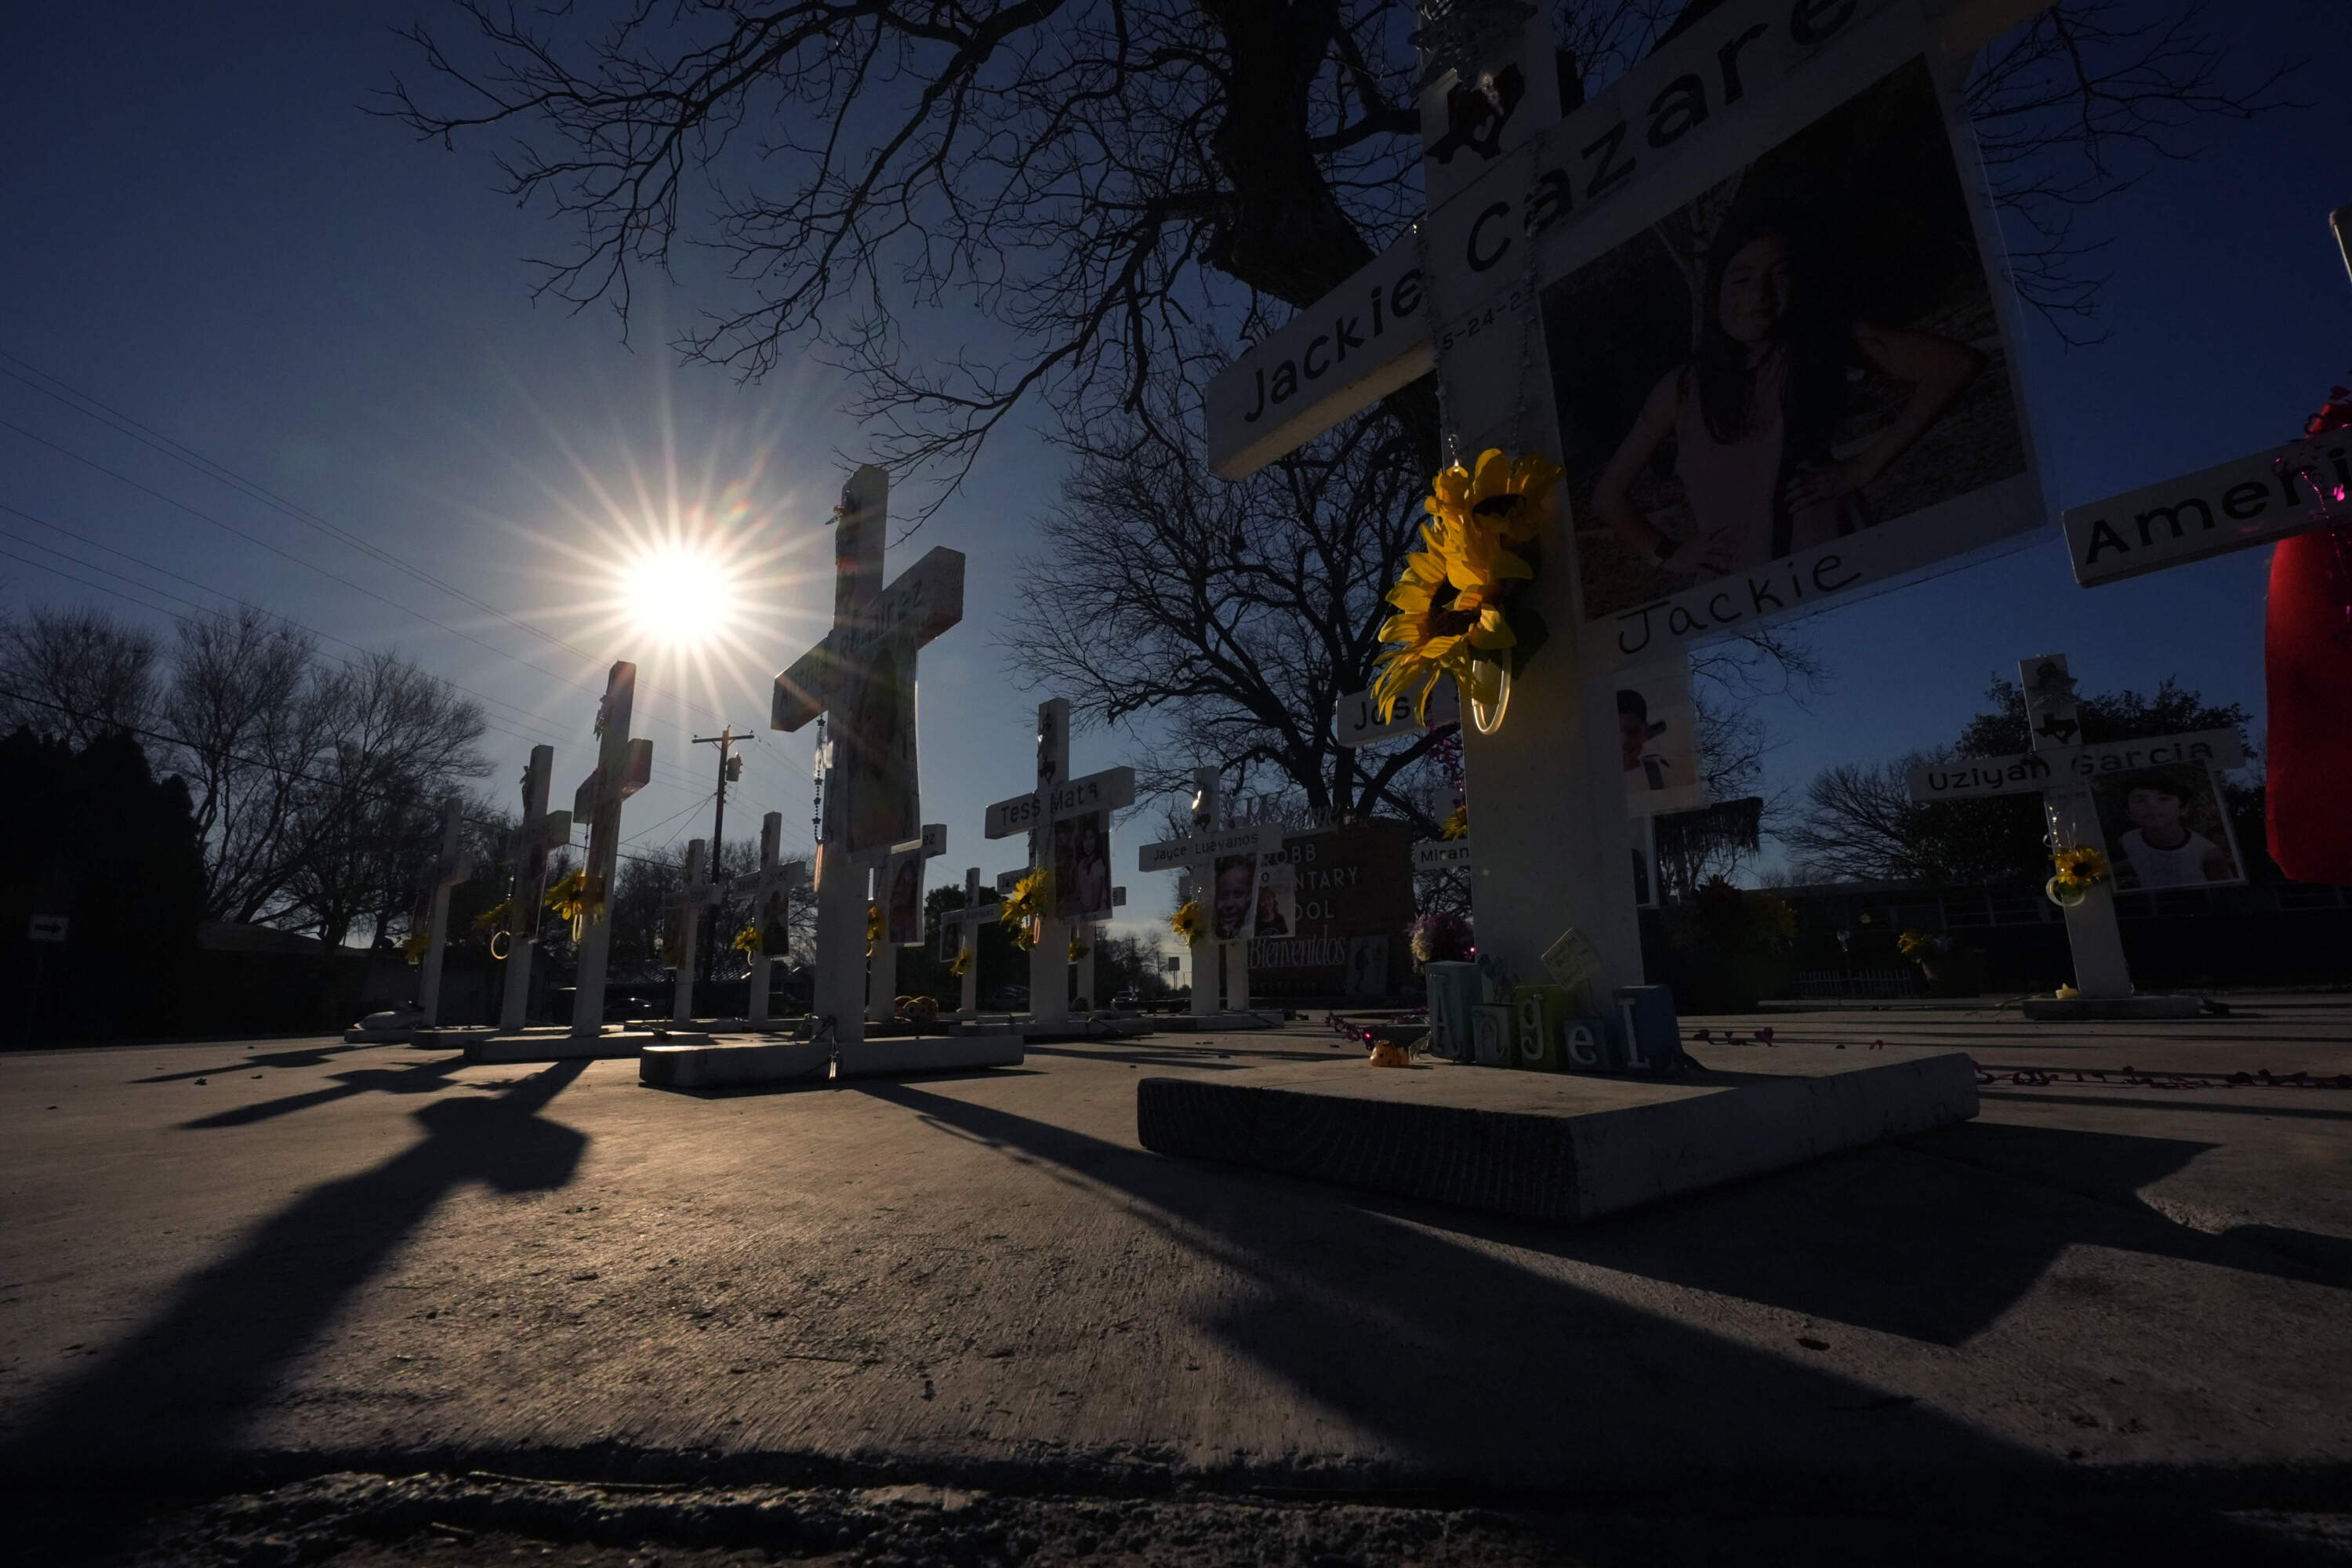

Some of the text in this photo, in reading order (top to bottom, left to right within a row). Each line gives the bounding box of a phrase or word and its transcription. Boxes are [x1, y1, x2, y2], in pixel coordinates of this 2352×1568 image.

[1244, 269, 1425, 423] Jackie
[1617, 554, 1862, 654] Jackie
[1353, 695, 1414, 731] Jos
[2071, 742, 2214, 775] Garcia
[1001, 782, 1098, 826] Tess Mata
[1153, 833, 1258, 861] Jayce Luevanos
[1261, 843, 1317, 867] ROBB
[1250, 924, 1345, 967] Bienvenidos
